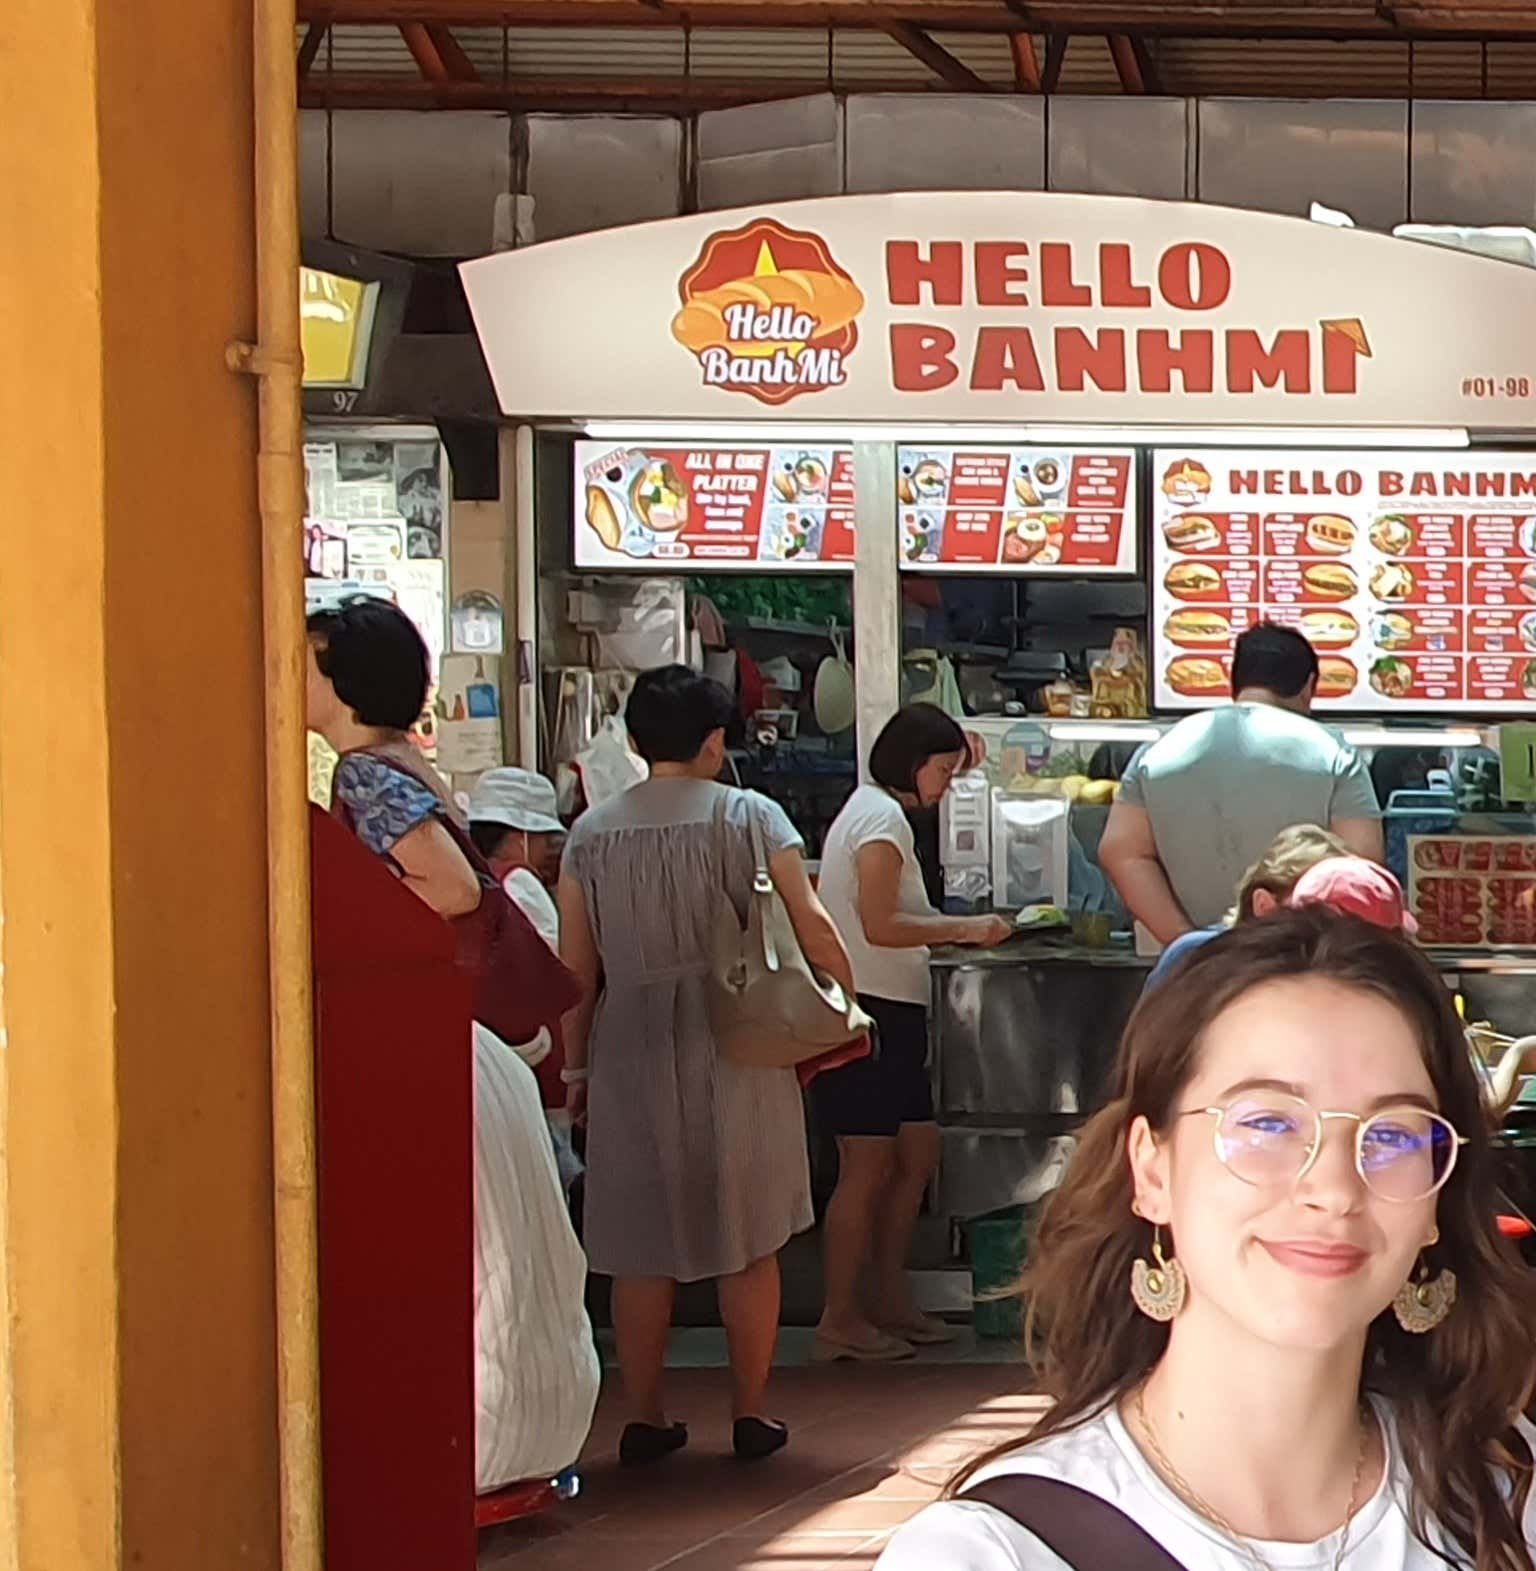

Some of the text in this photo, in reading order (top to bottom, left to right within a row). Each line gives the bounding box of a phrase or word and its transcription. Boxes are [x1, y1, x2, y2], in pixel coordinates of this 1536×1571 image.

[885, 241, 1231, 310] HELLO
[724, 303, 818, 341] Hello
[889, 321, 1362, 394] BANHMI
[1462, 376, 1530, 398] #01-98
[333, 390, 360, 413] 97
[685, 453, 711, 470] ALL
[692, 474, 758, 492] PLATTER
[1228, 469, 1363, 496] HELLO
